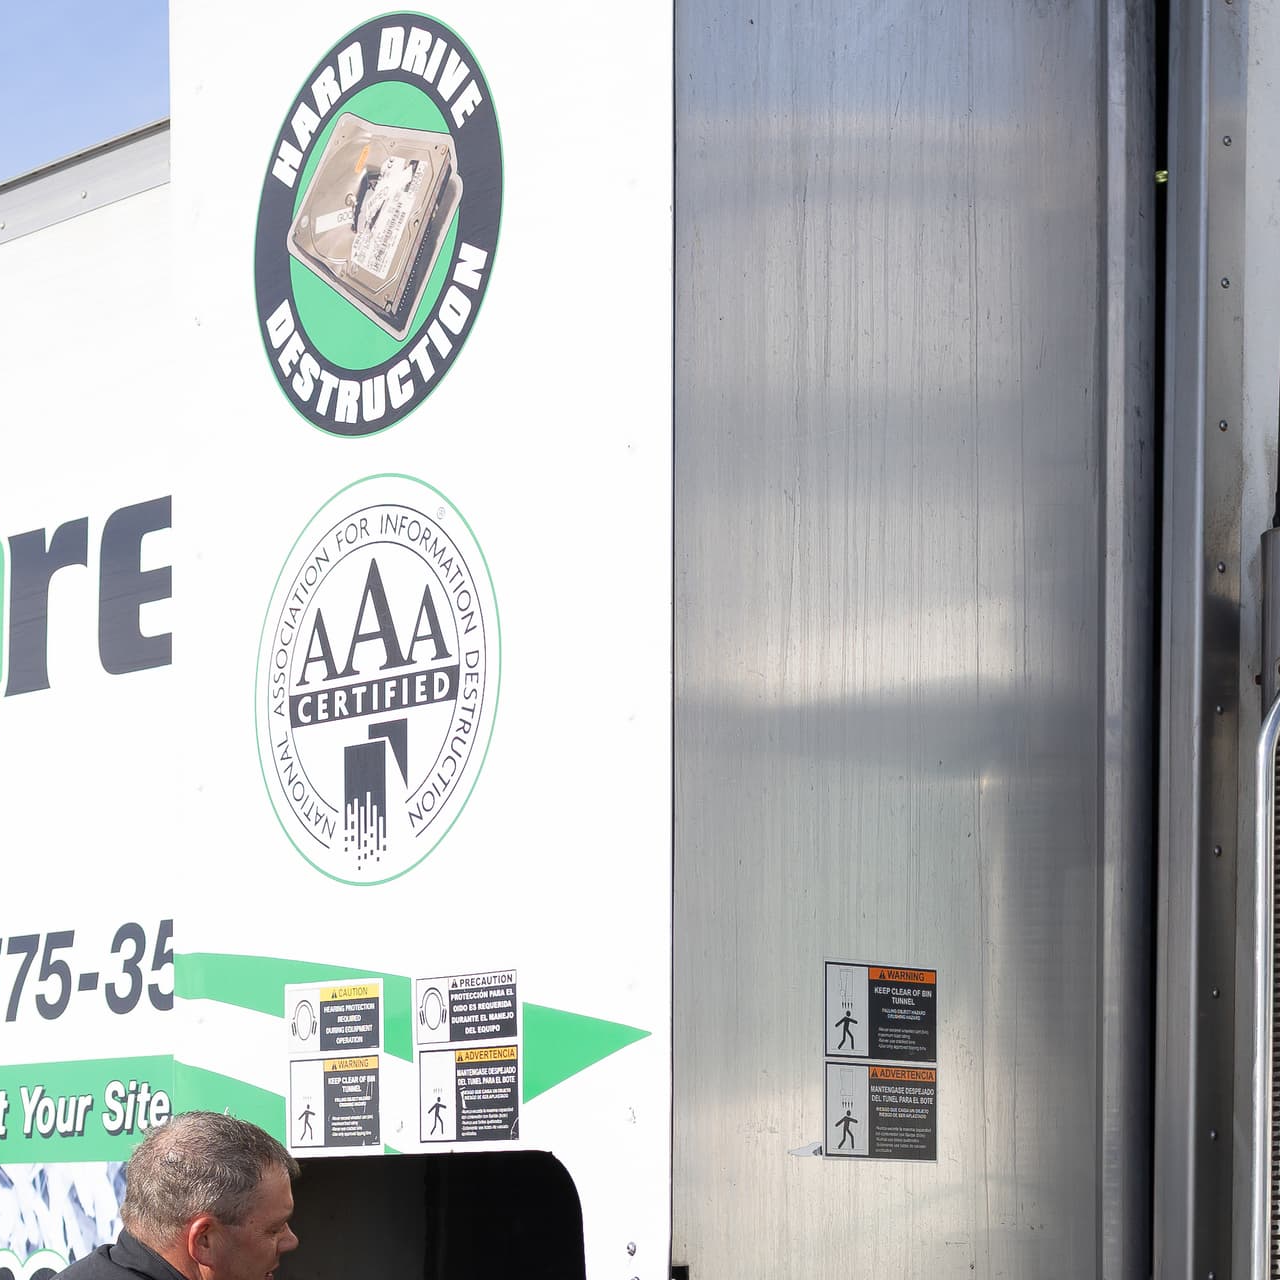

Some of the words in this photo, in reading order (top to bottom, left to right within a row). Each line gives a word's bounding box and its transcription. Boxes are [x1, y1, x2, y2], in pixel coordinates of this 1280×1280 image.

[272, 41, 364, 188] HARD
[377, 26, 483, 129] DRIVE
[266, 241, 488, 424] DESTRUCTION
[336, 518, 370, 551] FOR
[380, 514, 478, 635] INFORMATION
[273, 547, 330, 717] ASSOCIATION
[296, 558, 452, 686] AAA
[297, 671, 450, 723] CERTIFIED
[408, 650, 480, 828] DESTRUCTION
[276, 732, 337, 841] NATIONAL
[338, 987, 368, 998] CAUTION
[460, 974, 513, 988] PRECAUTION
[874, 986, 890, 995] KEEP
[891, 988, 912, 996] CLEAR
[912, 989, 921, 997] OF
[922, 990, 932, 998] BIN
[888, 971, 924, 981] WARNING
[891, 996, 915, 1006] TUNNEL
[464, 1049, 515, 1060] ADVERTENCIA
[880, 1069, 935, 1080] ADVERTENCIA
[19, 1086, 94, 1137] Your
[871, 1094, 882, 1102] DEL
